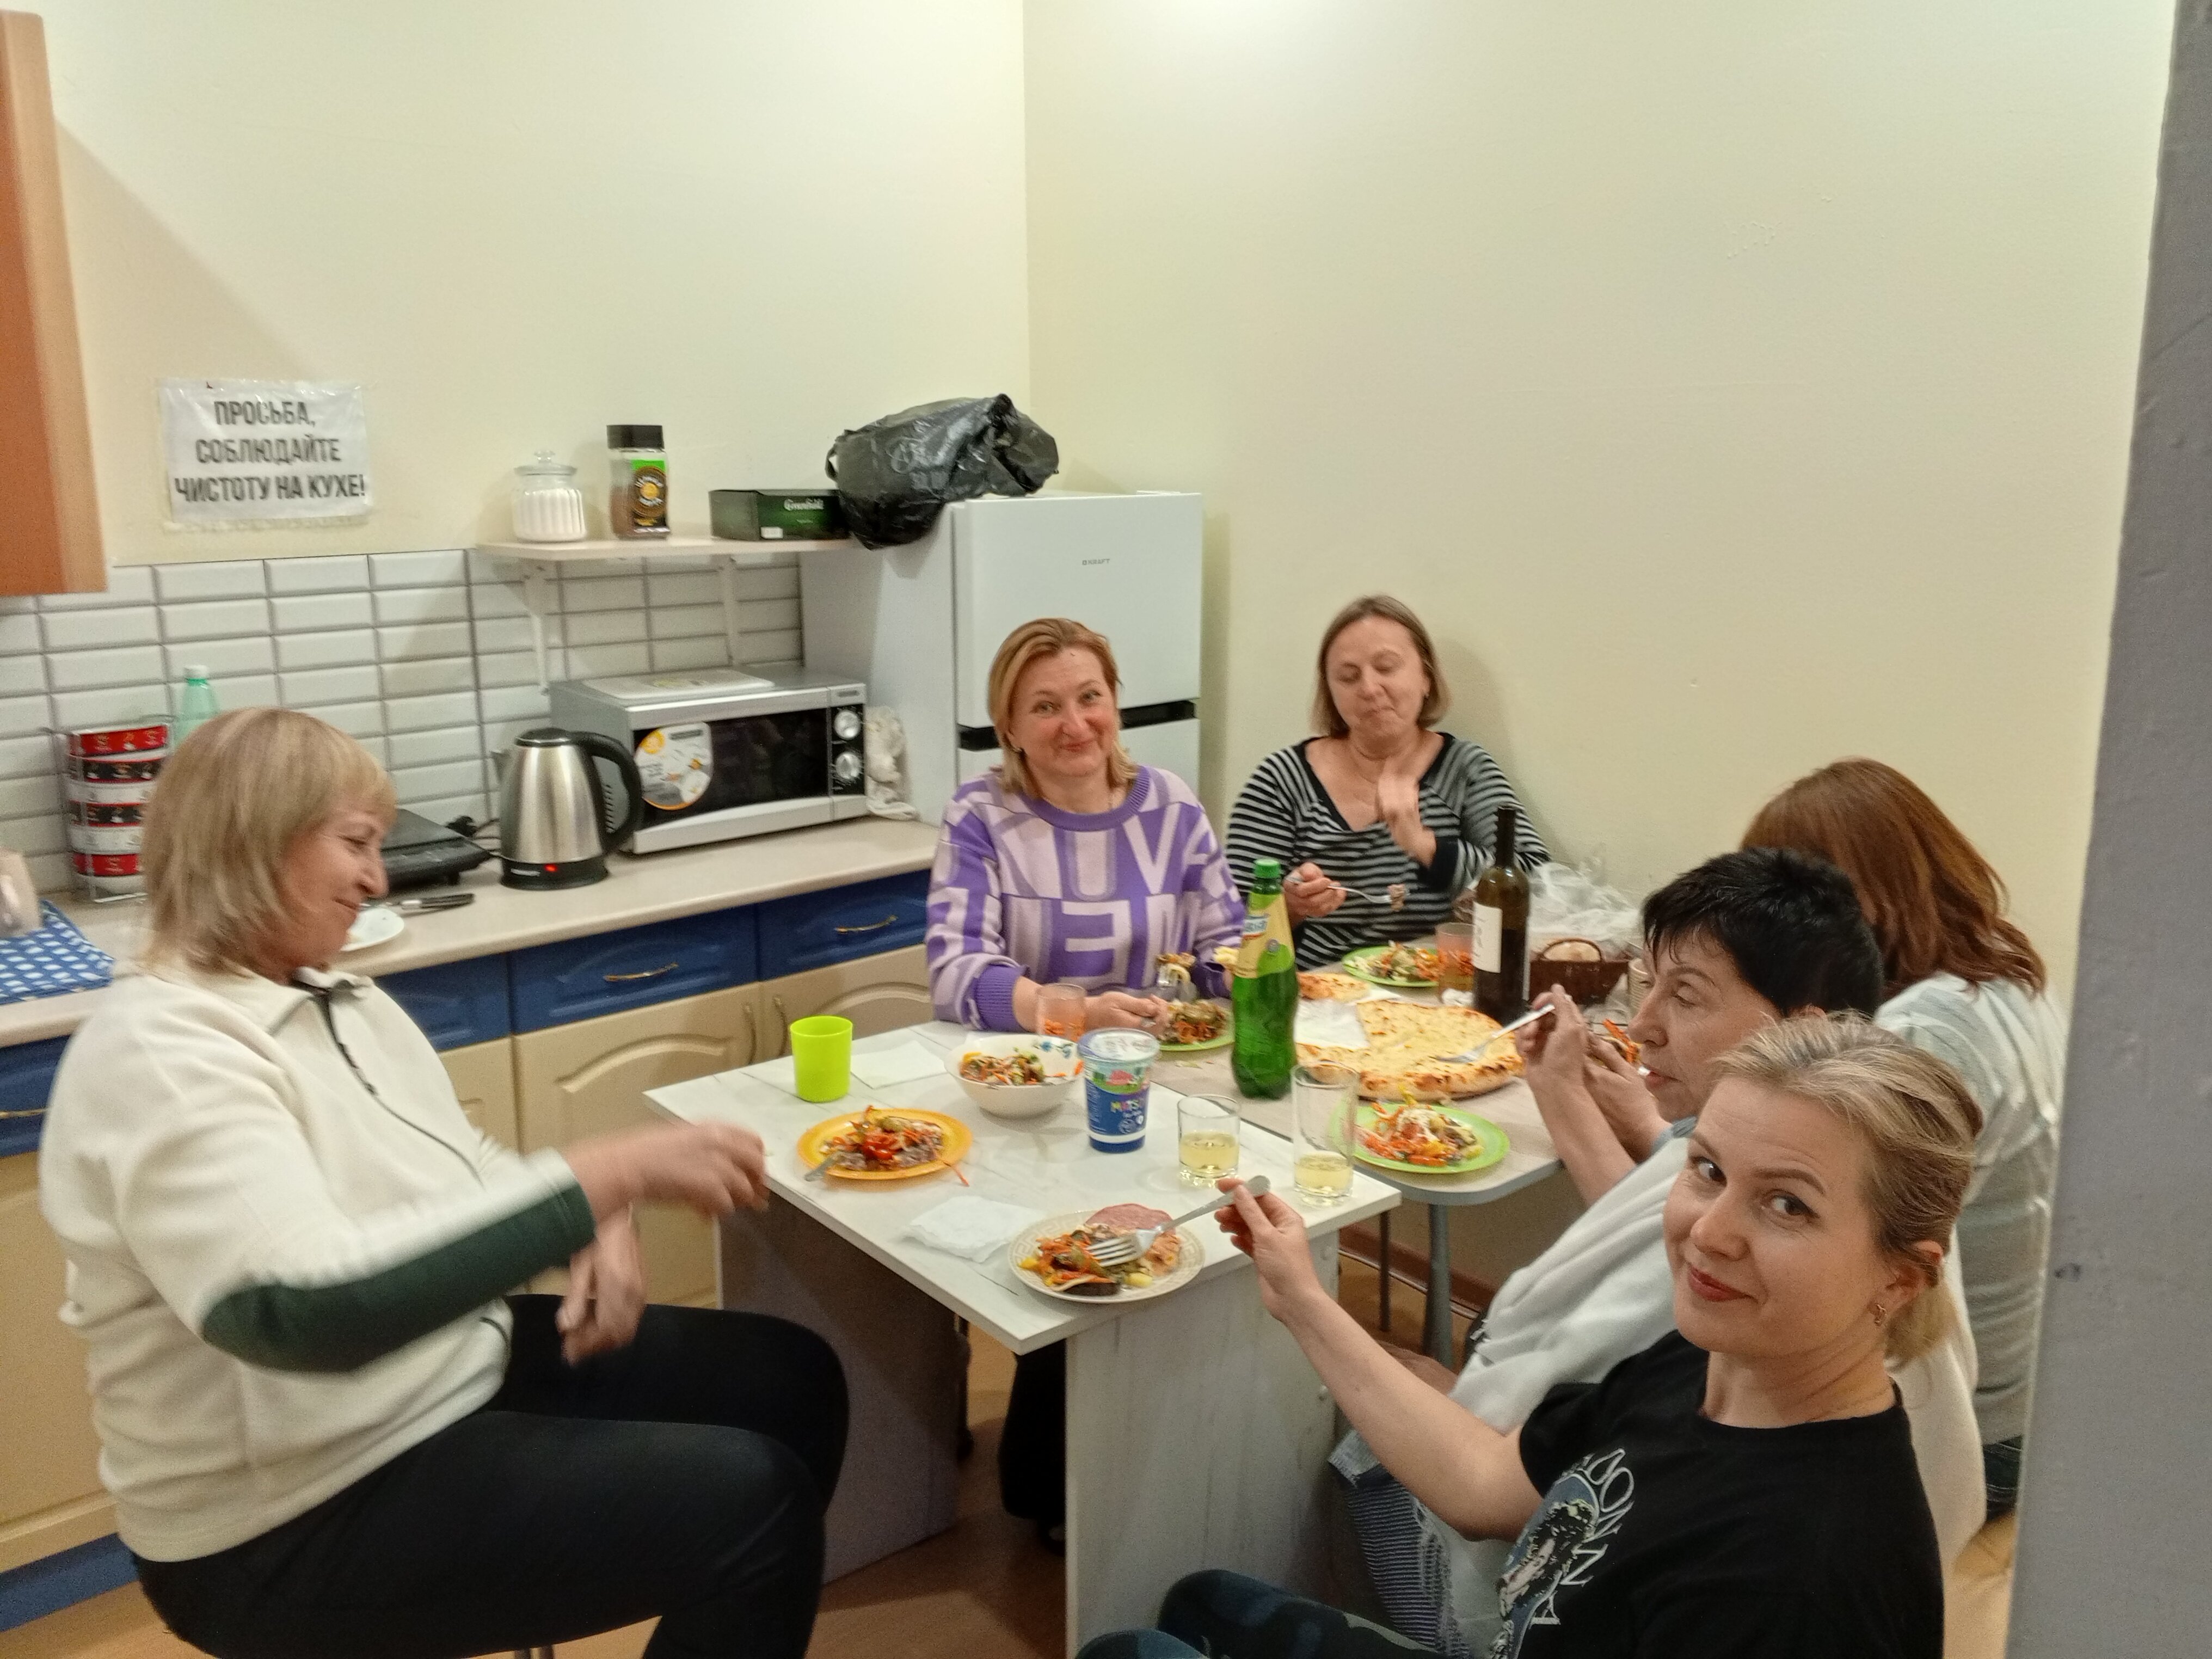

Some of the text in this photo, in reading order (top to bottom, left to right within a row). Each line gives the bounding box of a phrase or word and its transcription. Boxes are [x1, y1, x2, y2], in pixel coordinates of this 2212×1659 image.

[214, 401, 316, 427] ПРОСЬБА,
[195, 434, 341, 465] СОБЛЮДАЙТЕ
[174, 474, 365, 502] ЧИСТОТУ НА КУХЕ!
